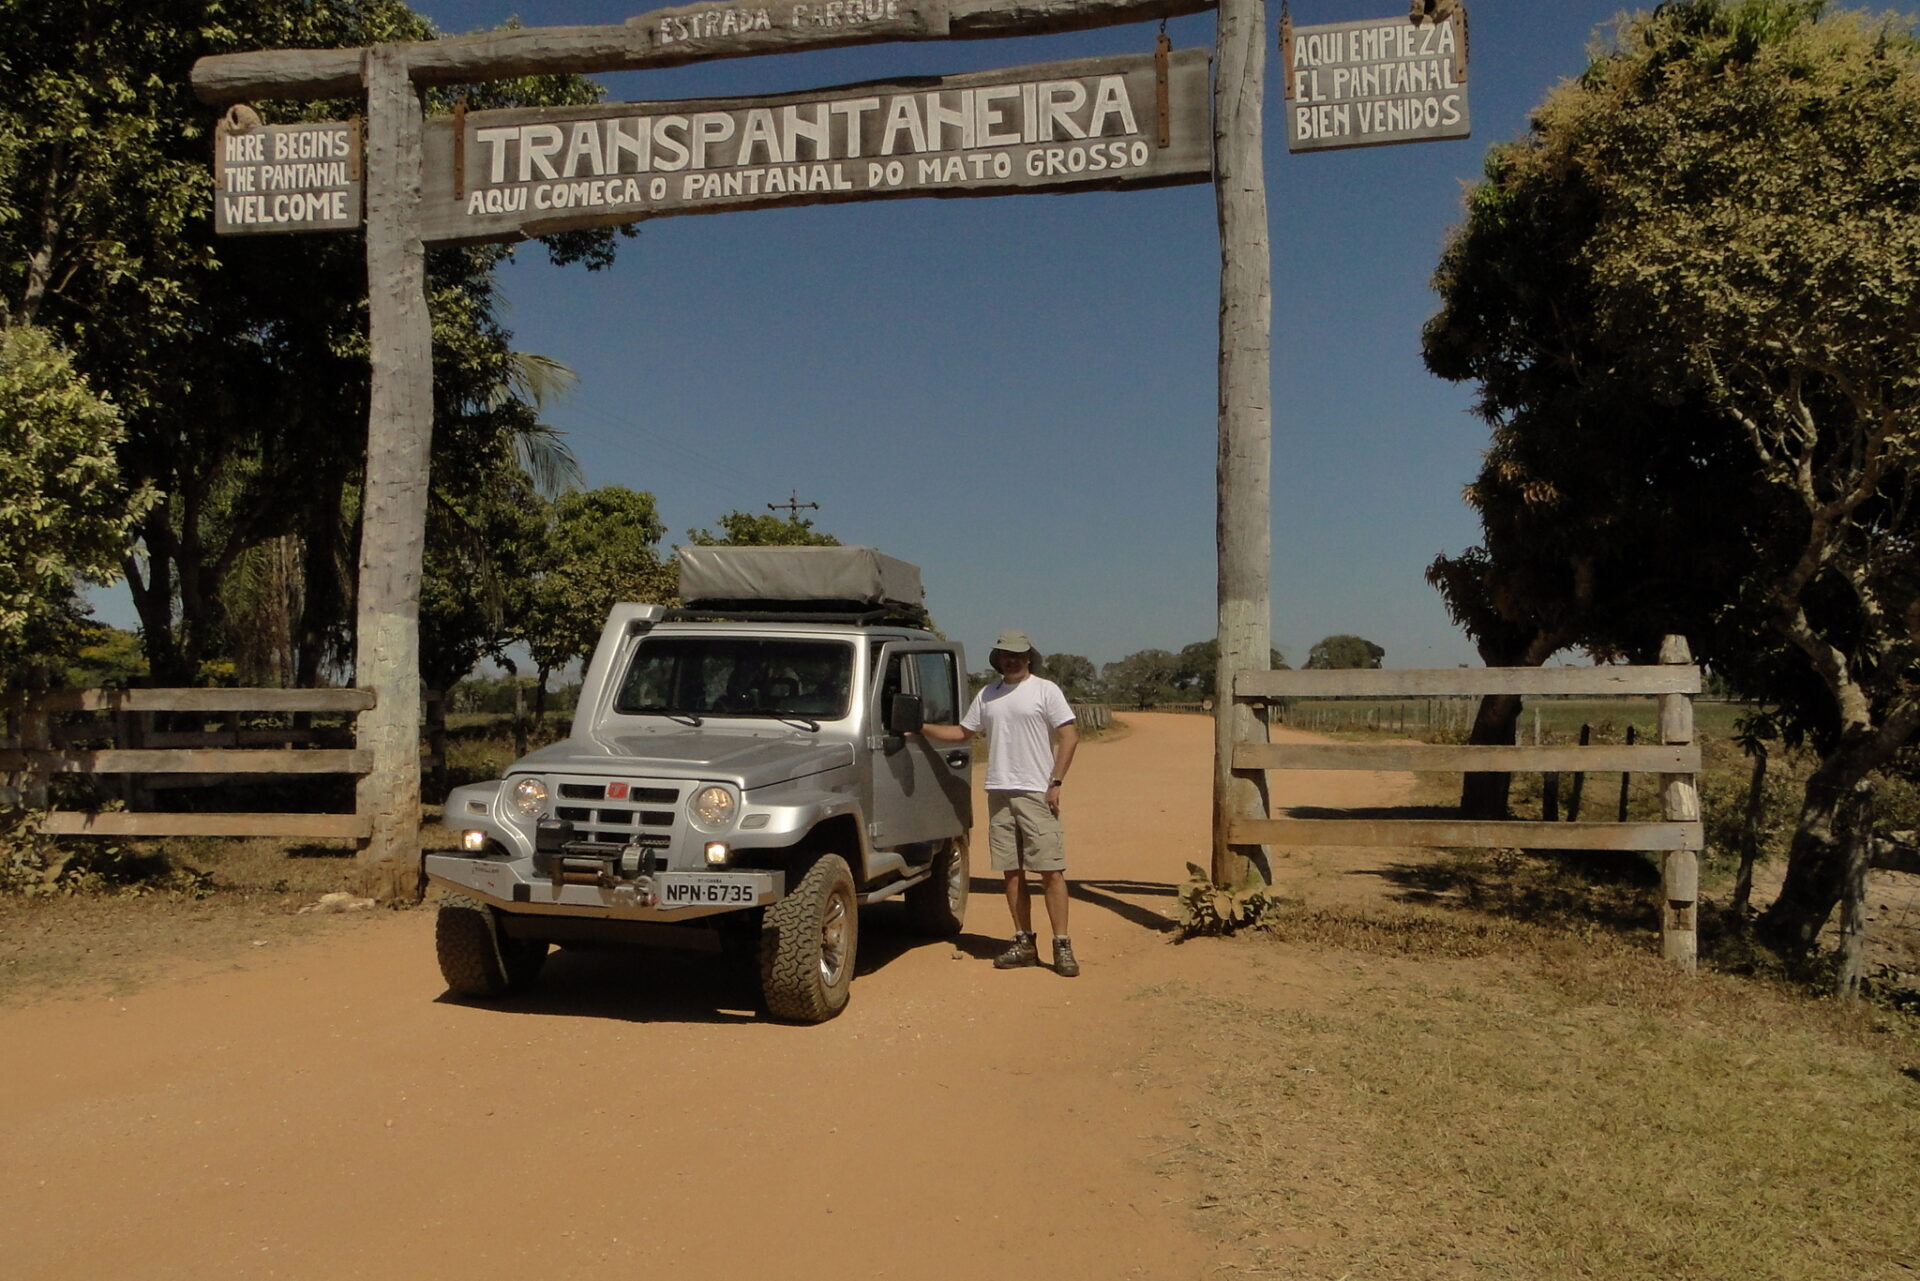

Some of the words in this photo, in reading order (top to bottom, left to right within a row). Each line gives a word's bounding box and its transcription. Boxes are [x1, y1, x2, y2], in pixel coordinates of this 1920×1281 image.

[660, 7, 772, 44] ESTRADA
[792, 0, 900, 27] PARQUE
[1293, 34, 1343, 68] AQUI
[1350, 16, 1456, 62] EMPIEZA
[1294, 66, 1327, 103] EL
[1333, 58, 1460, 99] PANTANAL
[476, 74, 1139, 184] TRANSPANTANEIRA
[1296, 103, 1350, 140] BIEN
[1356, 94, 1461, 134] VENIDOS
[225, 133, 266, 162] HERE
[274, 130, 350, 160] BEGINS
[224, 166, 256, 193] THE
[261, 161, 350, 191] PANTANAL
[467, 187, 528, 216] AQUI
[650, 177, 667, 200] O
[682, 163, 852, 200] PANTANAL
[868, 161, 905, 188] DO
[918, 152, 1013, 185] MATO
[1025, 141, 1149, 177] GROSSO
[223, 191, 348, 225] WELCOME
